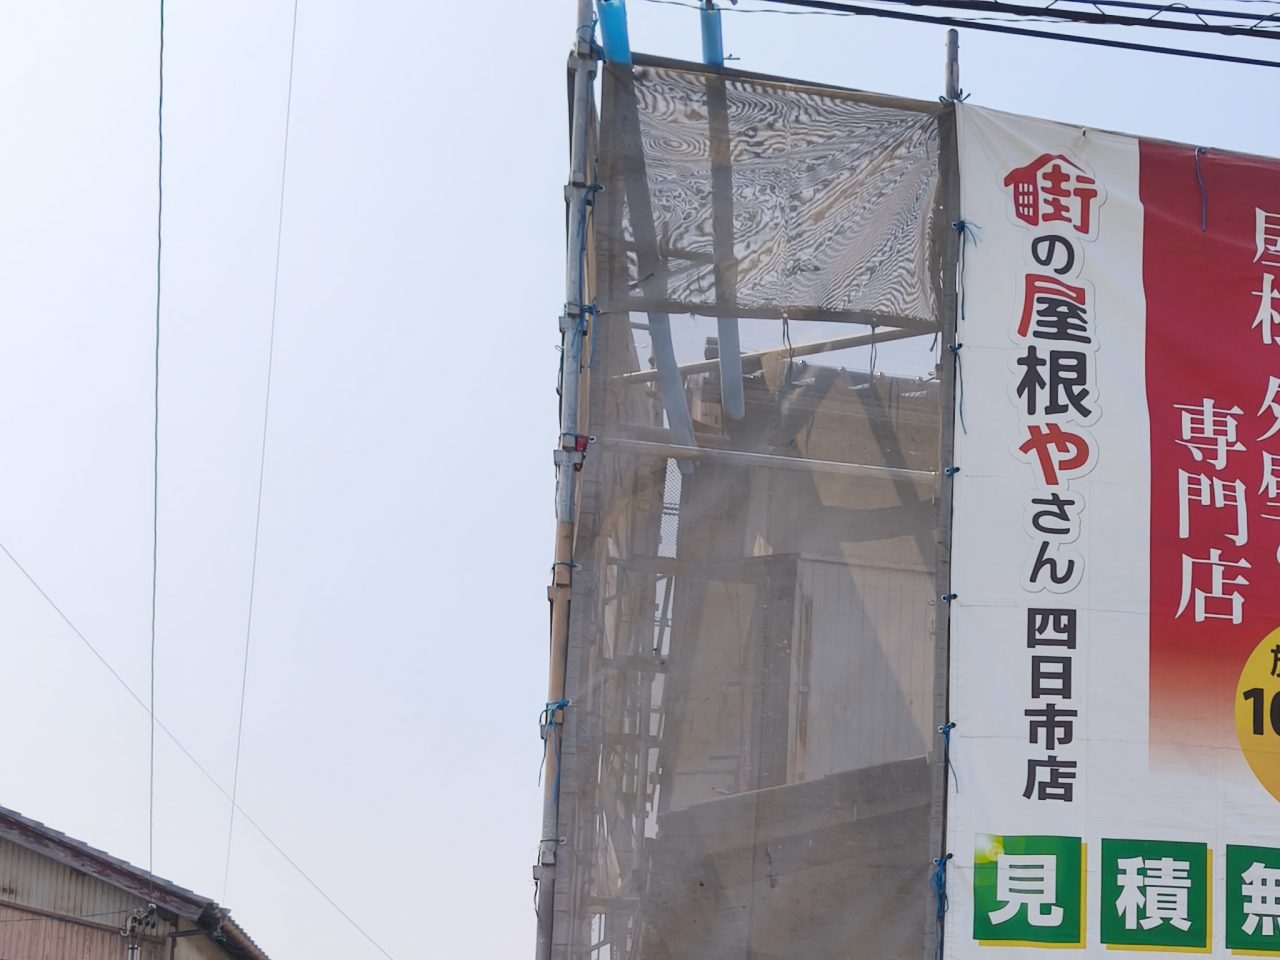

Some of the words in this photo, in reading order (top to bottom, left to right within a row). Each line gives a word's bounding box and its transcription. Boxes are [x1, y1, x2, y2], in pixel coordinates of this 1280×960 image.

[1003, 152, 1098, 585] 街の屋根やさん
[1174, 398, 1251, 625] 専門店
[1022, 607, 1077, 802] 四日市店
